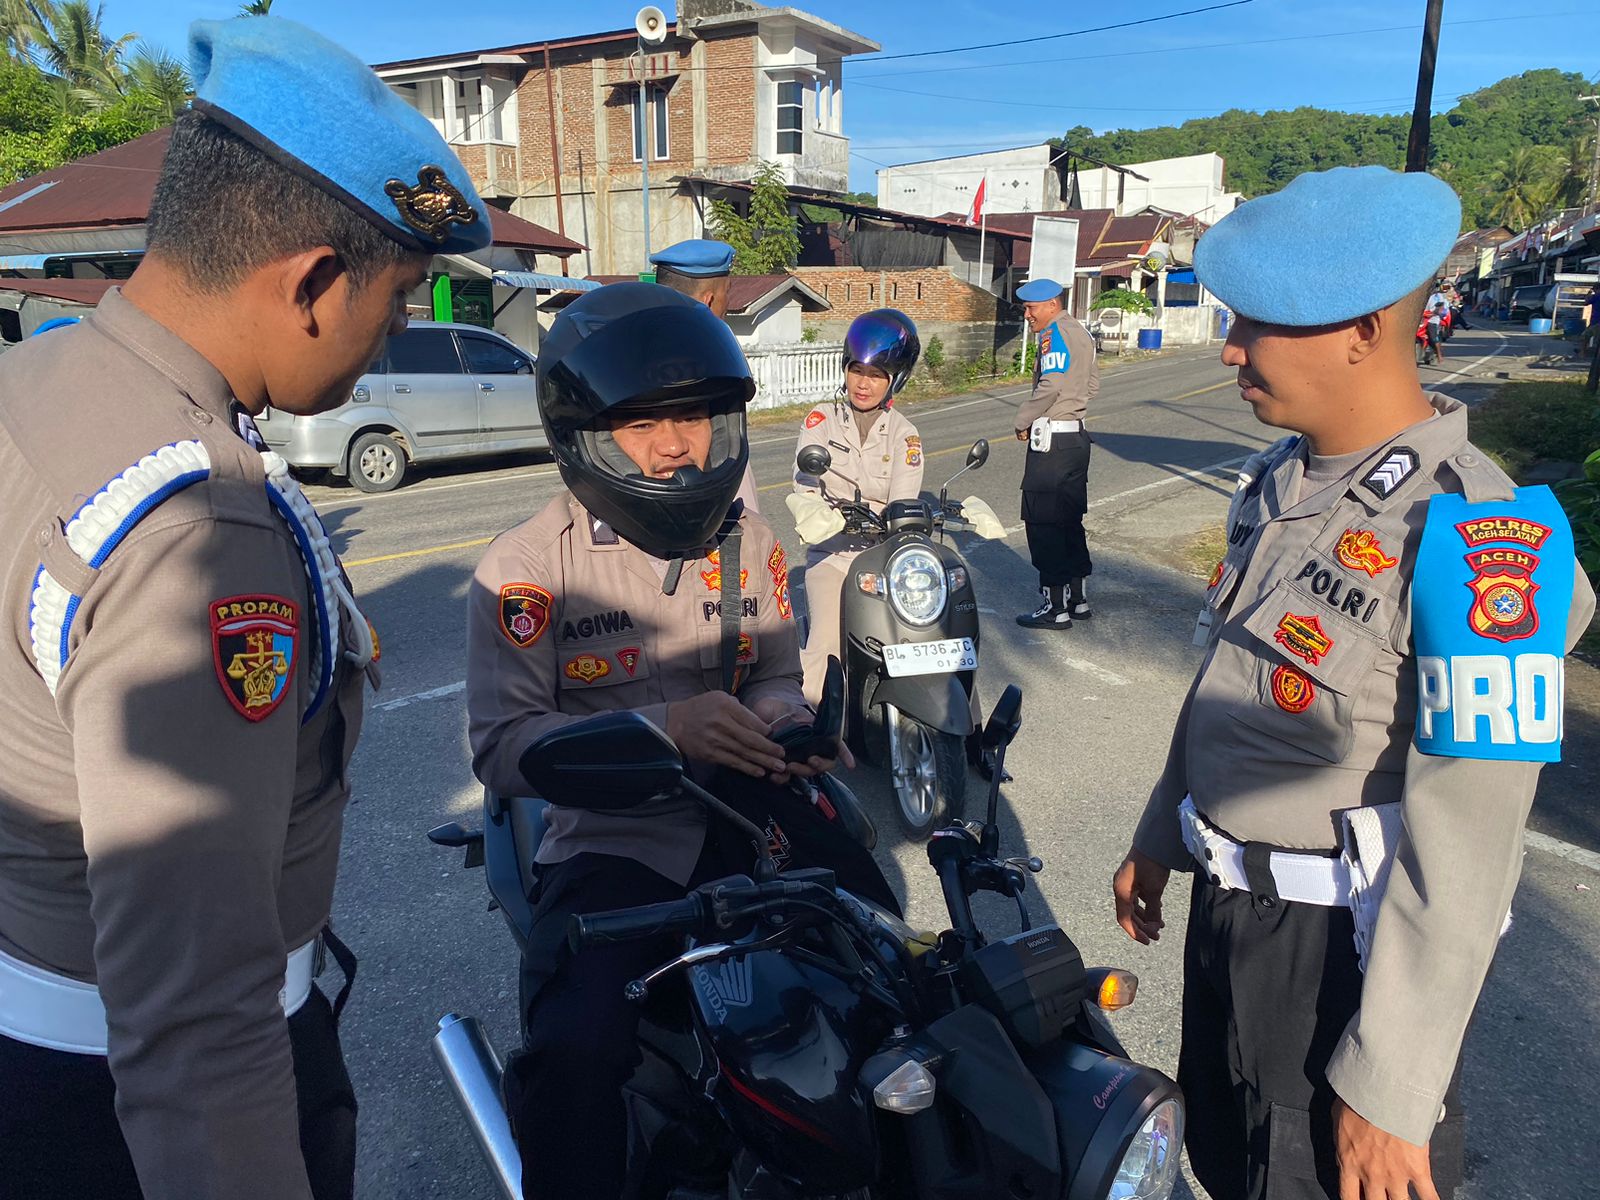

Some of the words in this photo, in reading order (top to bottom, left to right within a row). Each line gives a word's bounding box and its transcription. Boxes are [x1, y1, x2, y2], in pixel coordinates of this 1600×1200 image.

[1466, 519, 1544, 537] POLRES
[1472, 529, 1497, 541] ACEH
[1499, 529, 1538, 544] SELATAN
[1480, 554, 1530, 565] ACEH
[1295, 559, 1381, 624] POLRI
[217, 602, 293, 620] PROPAM
[703, 597, 758, 621] PRI
[563, 609, 634, 641] AGIWA
[886, 647, 900, 660] BL
[913, 643, 947, 657] 5736
[953, 640, 971, 653] TC
[1027, 936, 1050, 949] HONDA
